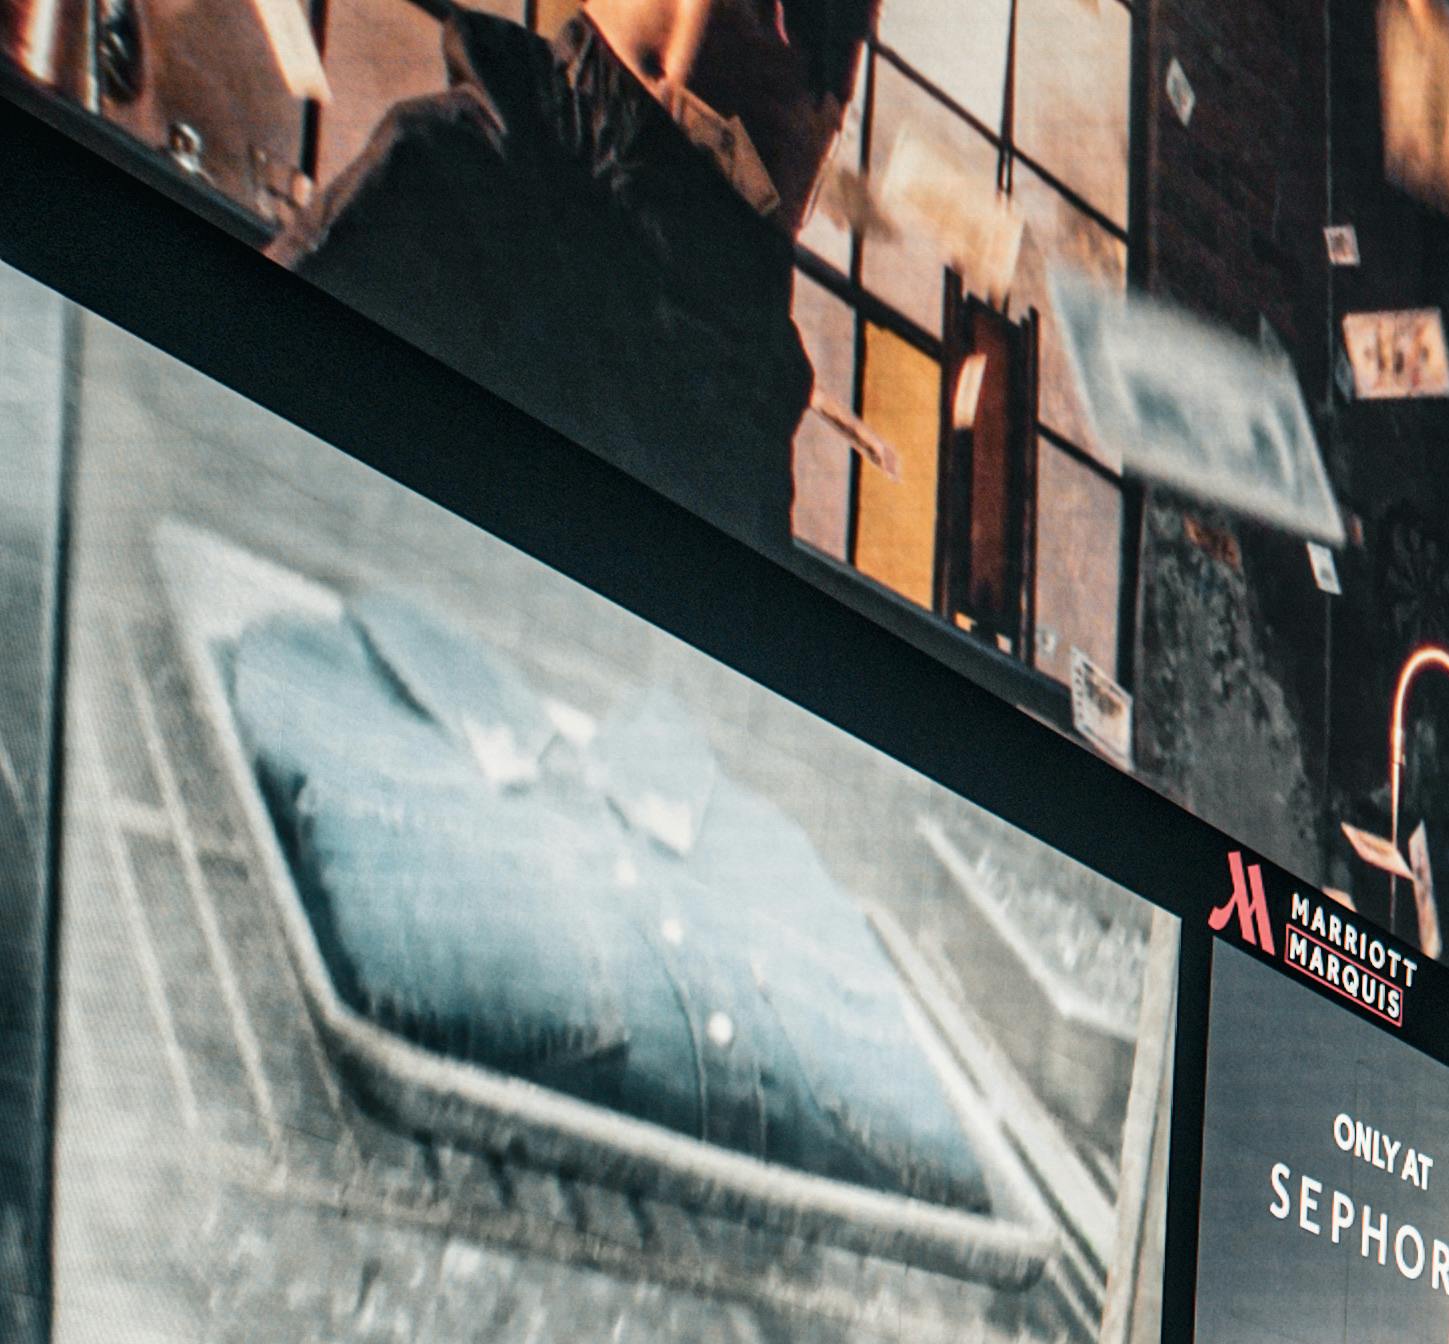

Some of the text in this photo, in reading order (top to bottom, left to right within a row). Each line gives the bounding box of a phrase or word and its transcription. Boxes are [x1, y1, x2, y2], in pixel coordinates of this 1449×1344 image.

[1288, 933, 1401, 1020] MARQUIS
[1291, 892, 1417, 988] MARRIOTT
[1333, 1113, 1434, 1191] ONLY AT
